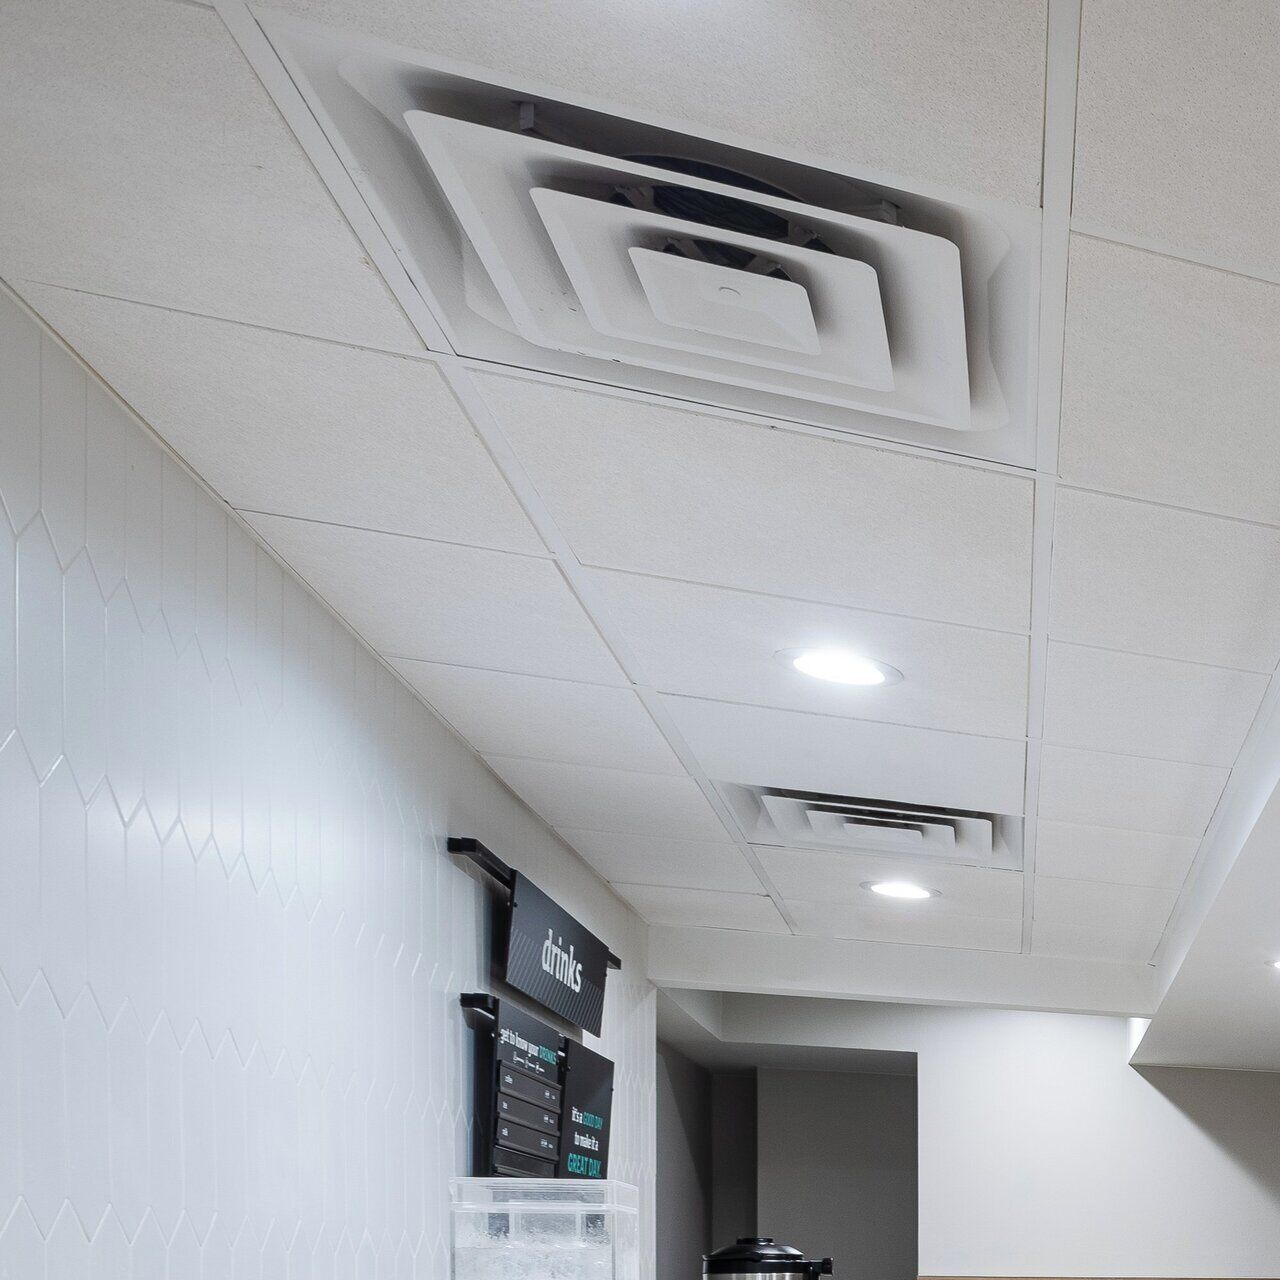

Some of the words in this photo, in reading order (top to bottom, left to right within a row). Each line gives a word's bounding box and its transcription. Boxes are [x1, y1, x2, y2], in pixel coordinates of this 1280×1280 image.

[542, 928, 582, 993] drinks
[500, 1029, 510, 1044] get
[510, 1030, 515, 1045] to
[515, 1032, 528, 1051] know
[528, 1043, 539, 1057] your
[568, 1153, 588, 1175] GREAT
